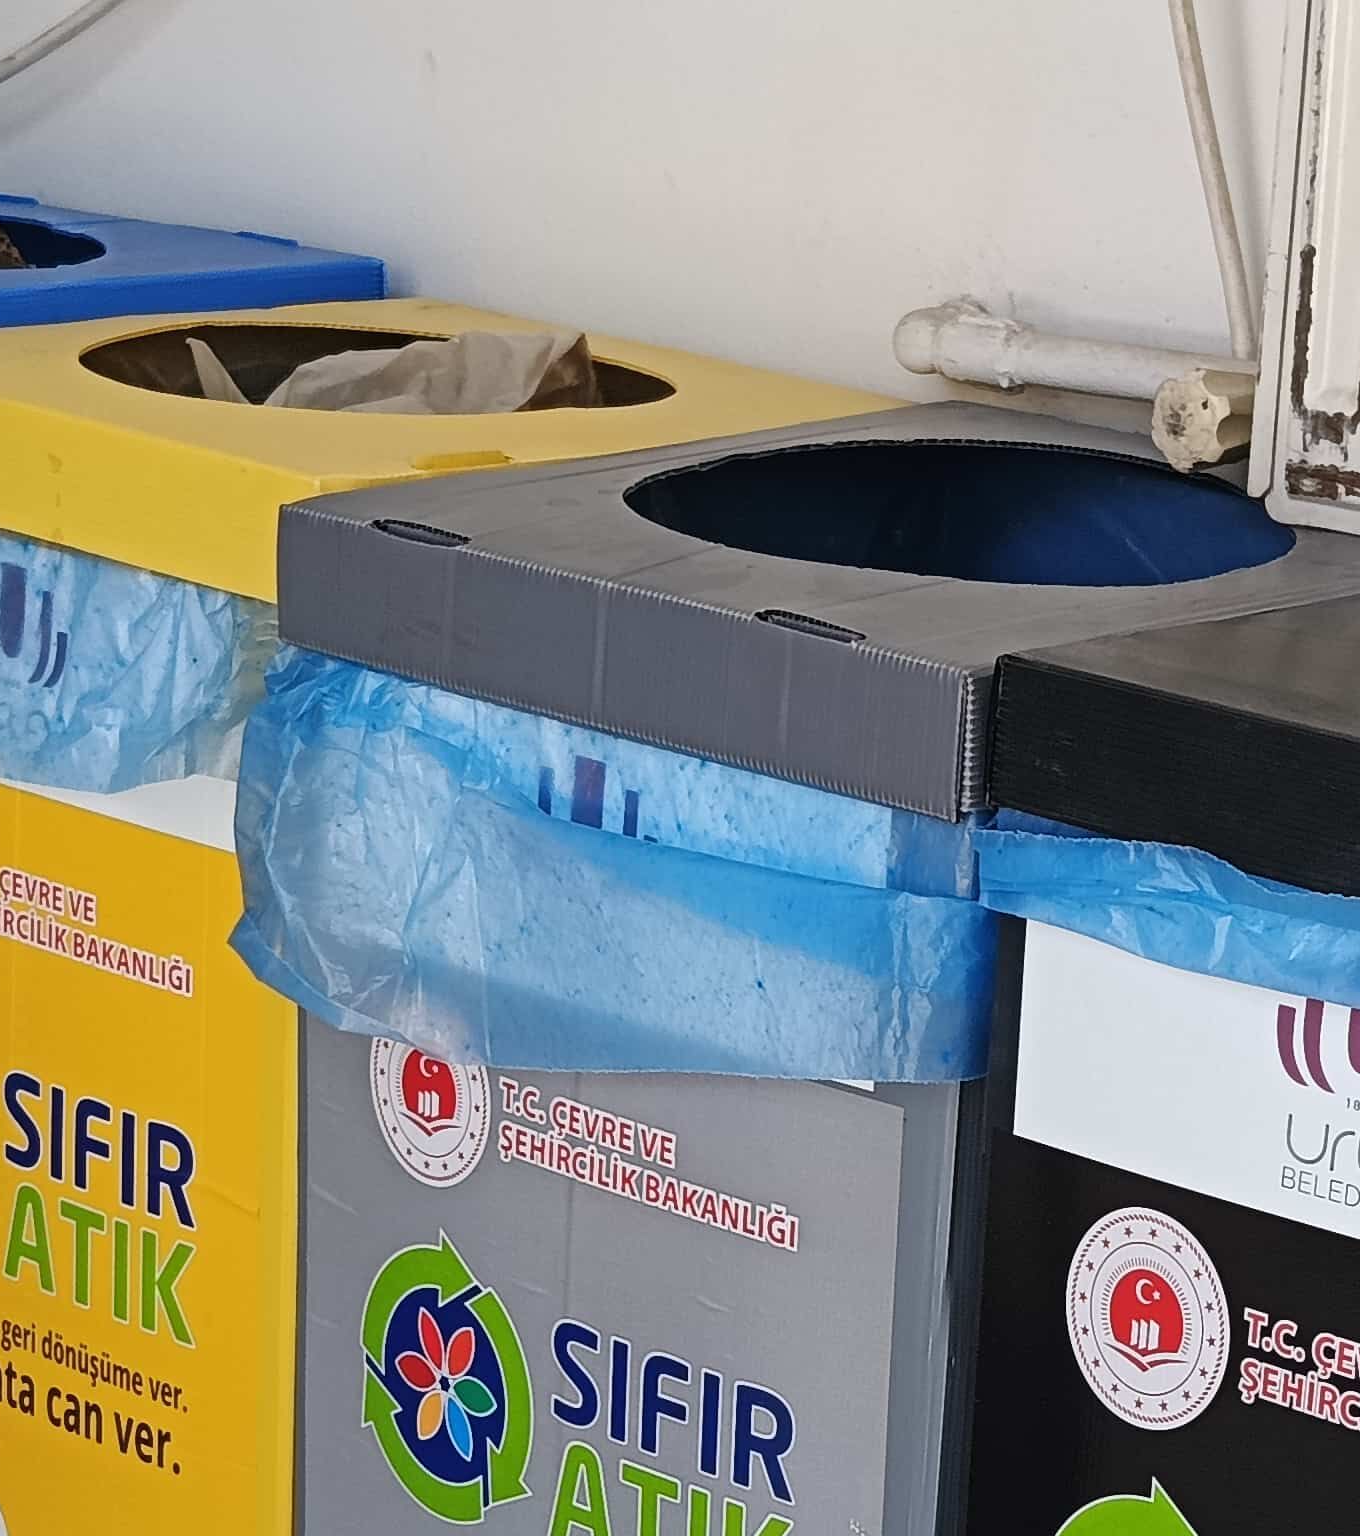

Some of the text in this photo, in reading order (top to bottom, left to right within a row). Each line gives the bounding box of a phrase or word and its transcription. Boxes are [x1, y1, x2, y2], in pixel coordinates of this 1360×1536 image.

[0, 869, 65, 913] ÇEVRE
[69, 888, 96, 924] VE
[72, 929, 192, 997] BAKANLIĞI
[2, 1070, 196, 1230] SIFIR
[500, 1076, 675, 1167] T.C. ÇEVRE VE
[500, 1124, 799, 1252] ŞEHİRCİLİK BAKANLIĞI
[2, 1183, 196, 1348] ATIK
[1, 1318, 35, 1354] geri
[41, 1329, 143, 1396] dönüşüme
[149, 1376, 188, 1413] ver.
[1243, 1307, 1305, 1363] T.C.
[46, 1387, 102, 1445] can
[113, 1411, 181, 1475] ver.
[550, 1318, 796, 1505] SIFIR
